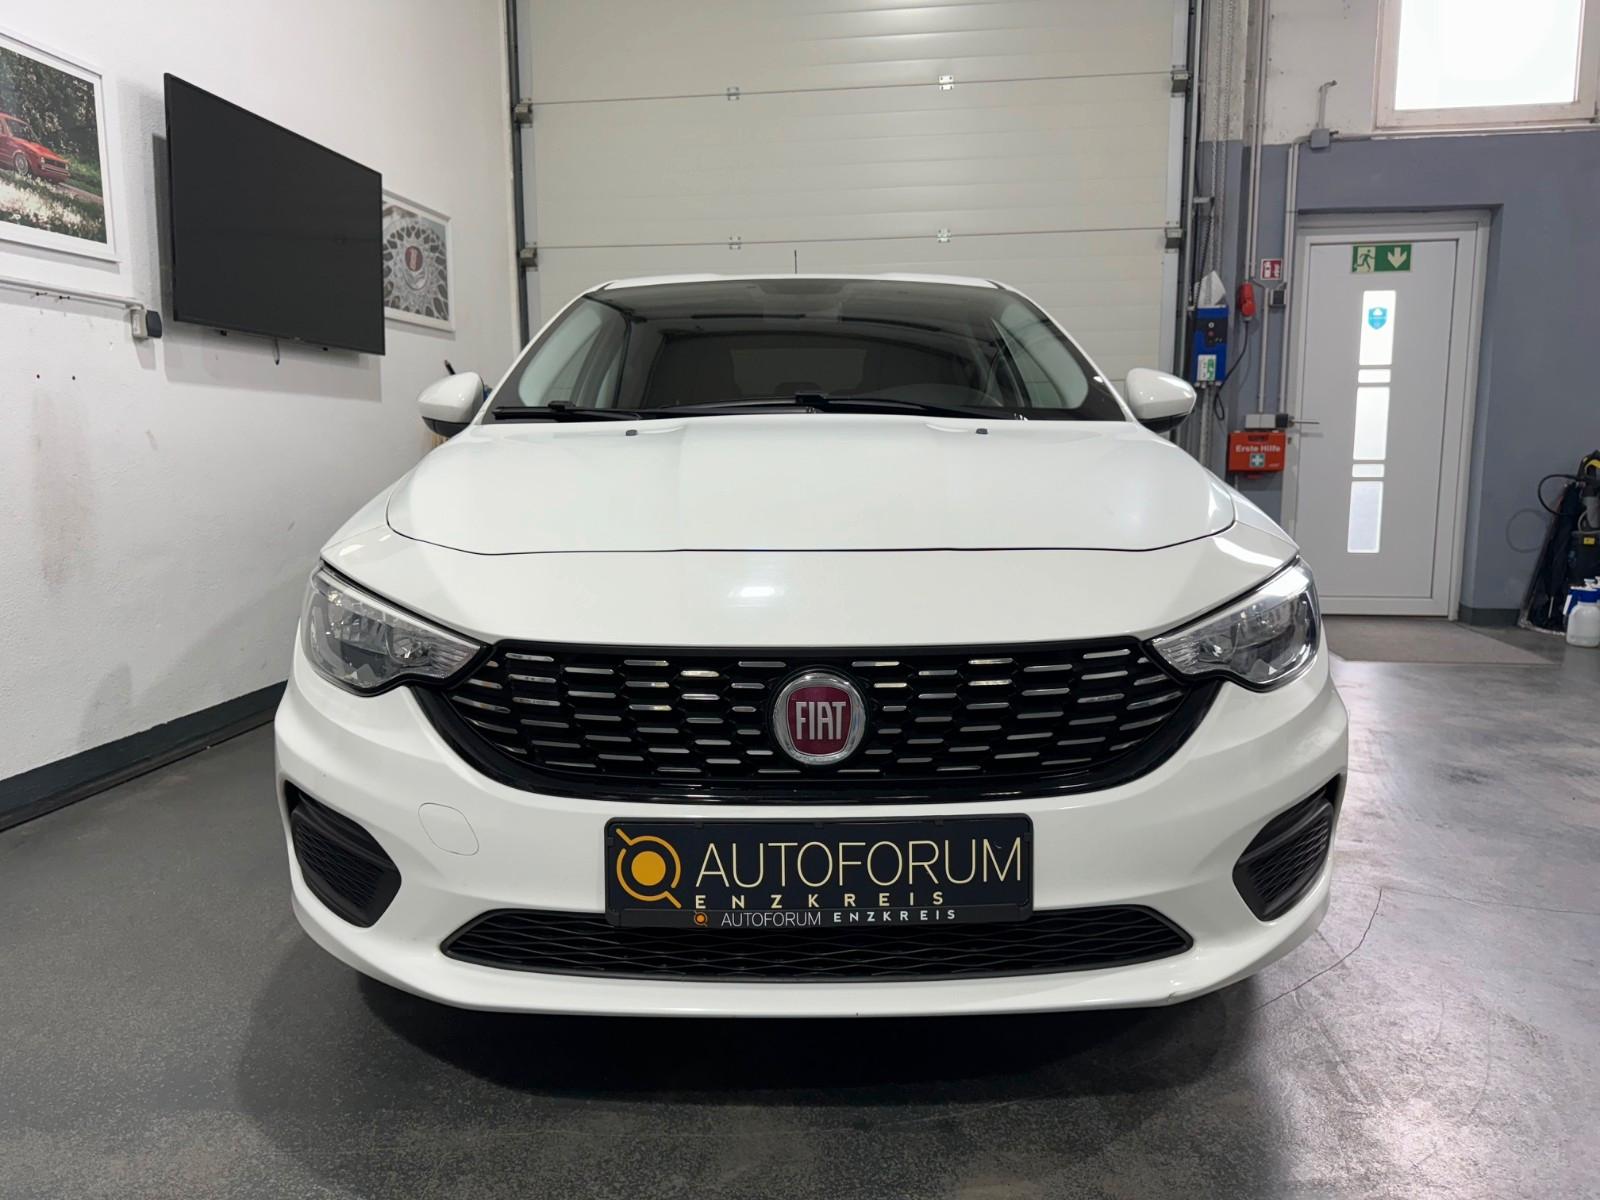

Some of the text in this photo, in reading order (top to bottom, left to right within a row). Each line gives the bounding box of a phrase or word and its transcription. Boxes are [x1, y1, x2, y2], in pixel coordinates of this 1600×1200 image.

[1235, 444, 1281, 453] Erste Hilfe
[795, 701, 847, 740] FIAT
[695, 836, 1022, 889] AUTOFORUM
[694, 891, 945, 910] ENZKREIS
[720, 909, 956, 928] AUTOFORUM ENZKREIS
